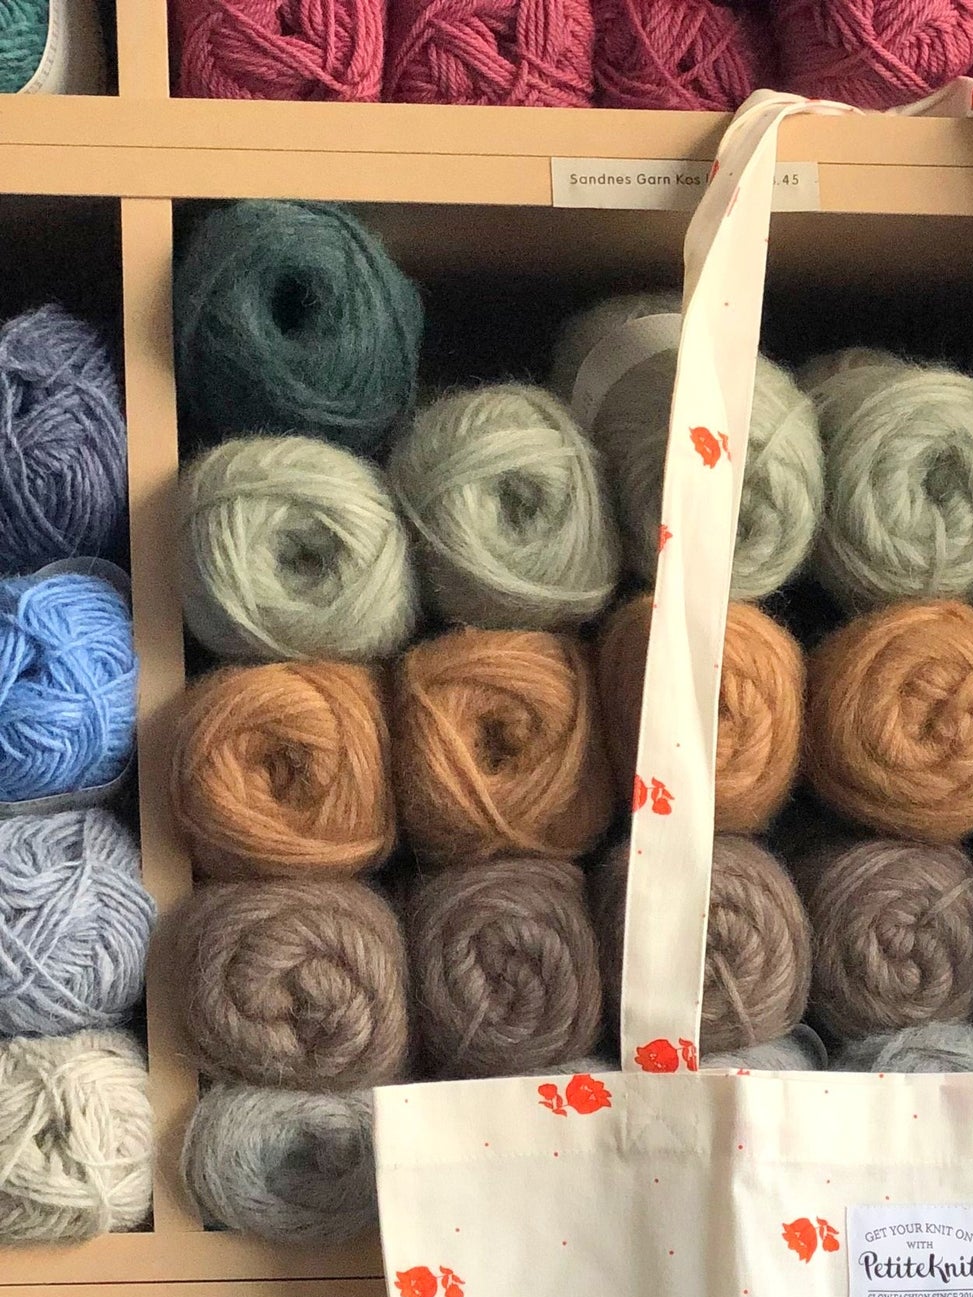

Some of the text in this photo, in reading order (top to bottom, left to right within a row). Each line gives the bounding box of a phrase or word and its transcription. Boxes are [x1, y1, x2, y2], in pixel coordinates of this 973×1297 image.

[570, 173, 631, 185] Sandnes
[636, 173, 671, 185] Garn
[675, 174, 700, 186] Kos
[865, 1223, 973, 1243] GET YOUR KNIT ON
[906, 1241, 933, 1249] WITH
